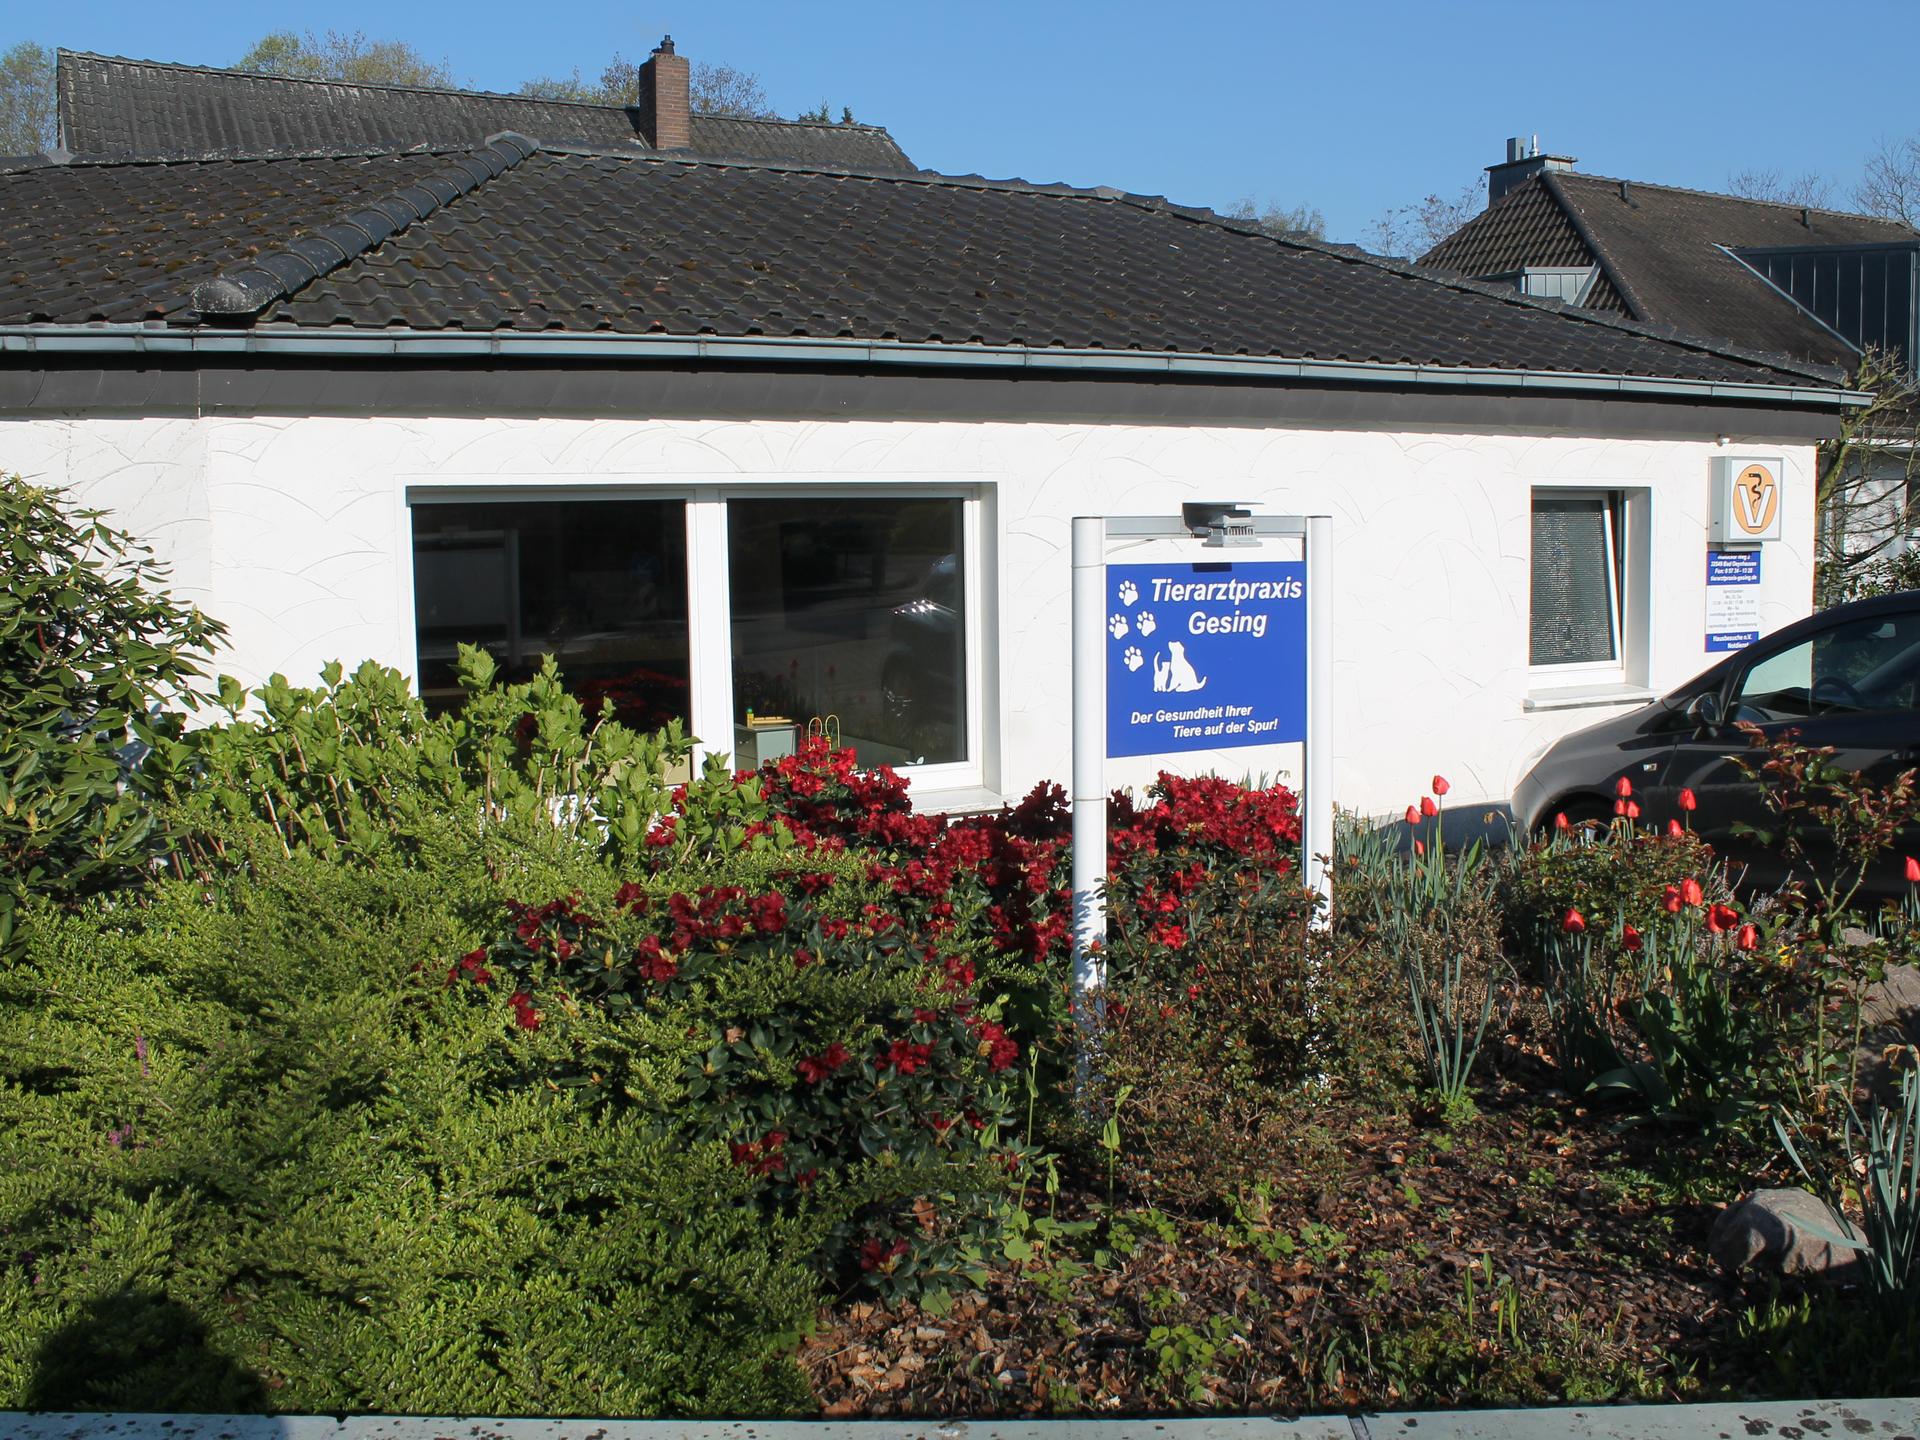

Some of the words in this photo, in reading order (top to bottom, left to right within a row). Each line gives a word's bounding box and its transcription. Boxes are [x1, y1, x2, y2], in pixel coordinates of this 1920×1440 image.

[1151, 576, 1302, 605] Tierarztpraxis
[1188, 610, 1268, 637] Gesing
[1131, 711, 1153, 724] Der
[1156, 706, 1223, 723] Gesundheit
[1226, 705, 1253, 717] Ihrer
[1173, 725, 1202, 738] Tiere
[1204, 722, 1224, 735] auf
[1226, 721, 1245, 734] der
[1248, 718, 1279, 734] Spur!
